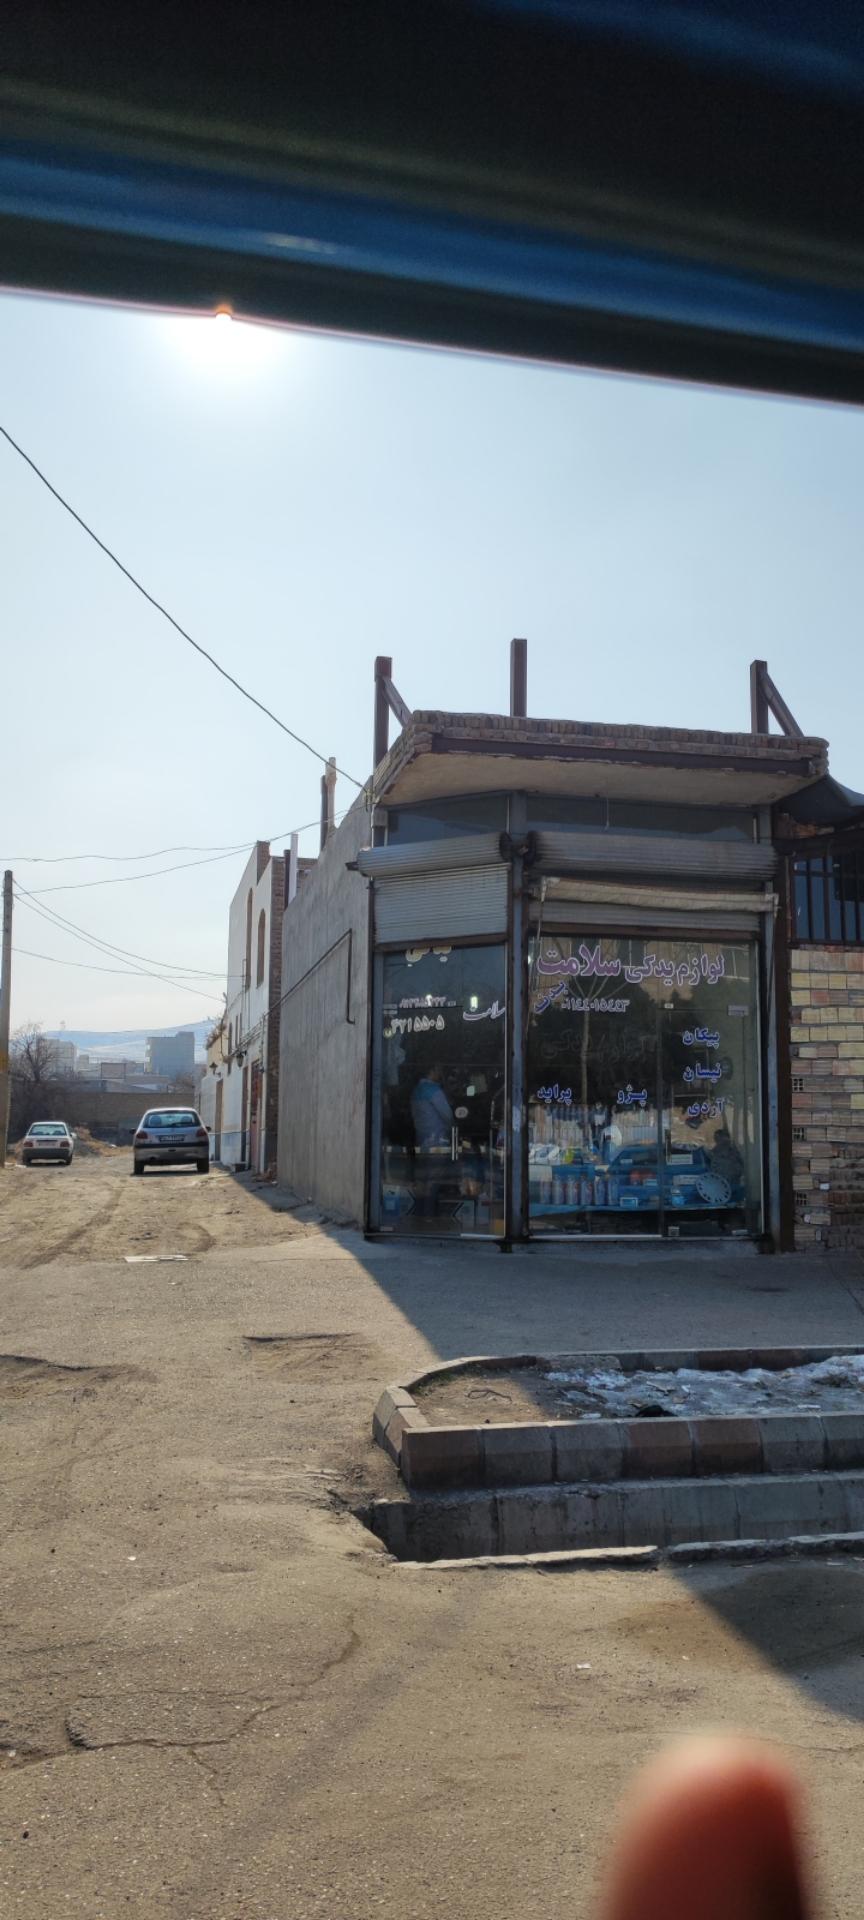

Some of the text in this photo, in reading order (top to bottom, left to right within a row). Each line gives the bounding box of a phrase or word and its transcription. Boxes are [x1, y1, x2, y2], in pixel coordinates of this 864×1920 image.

[537, 943, 725, 986] لوازم یدکی سلامت
[682, 1028, 720, 1049] پیکان
[683, 1062, 722, 1083] نیسان
[537, 1083, 572, 1105] پراید
[617, 1084, 648, 1107] پژو
[687, 1097, 725, 1117] آردی
